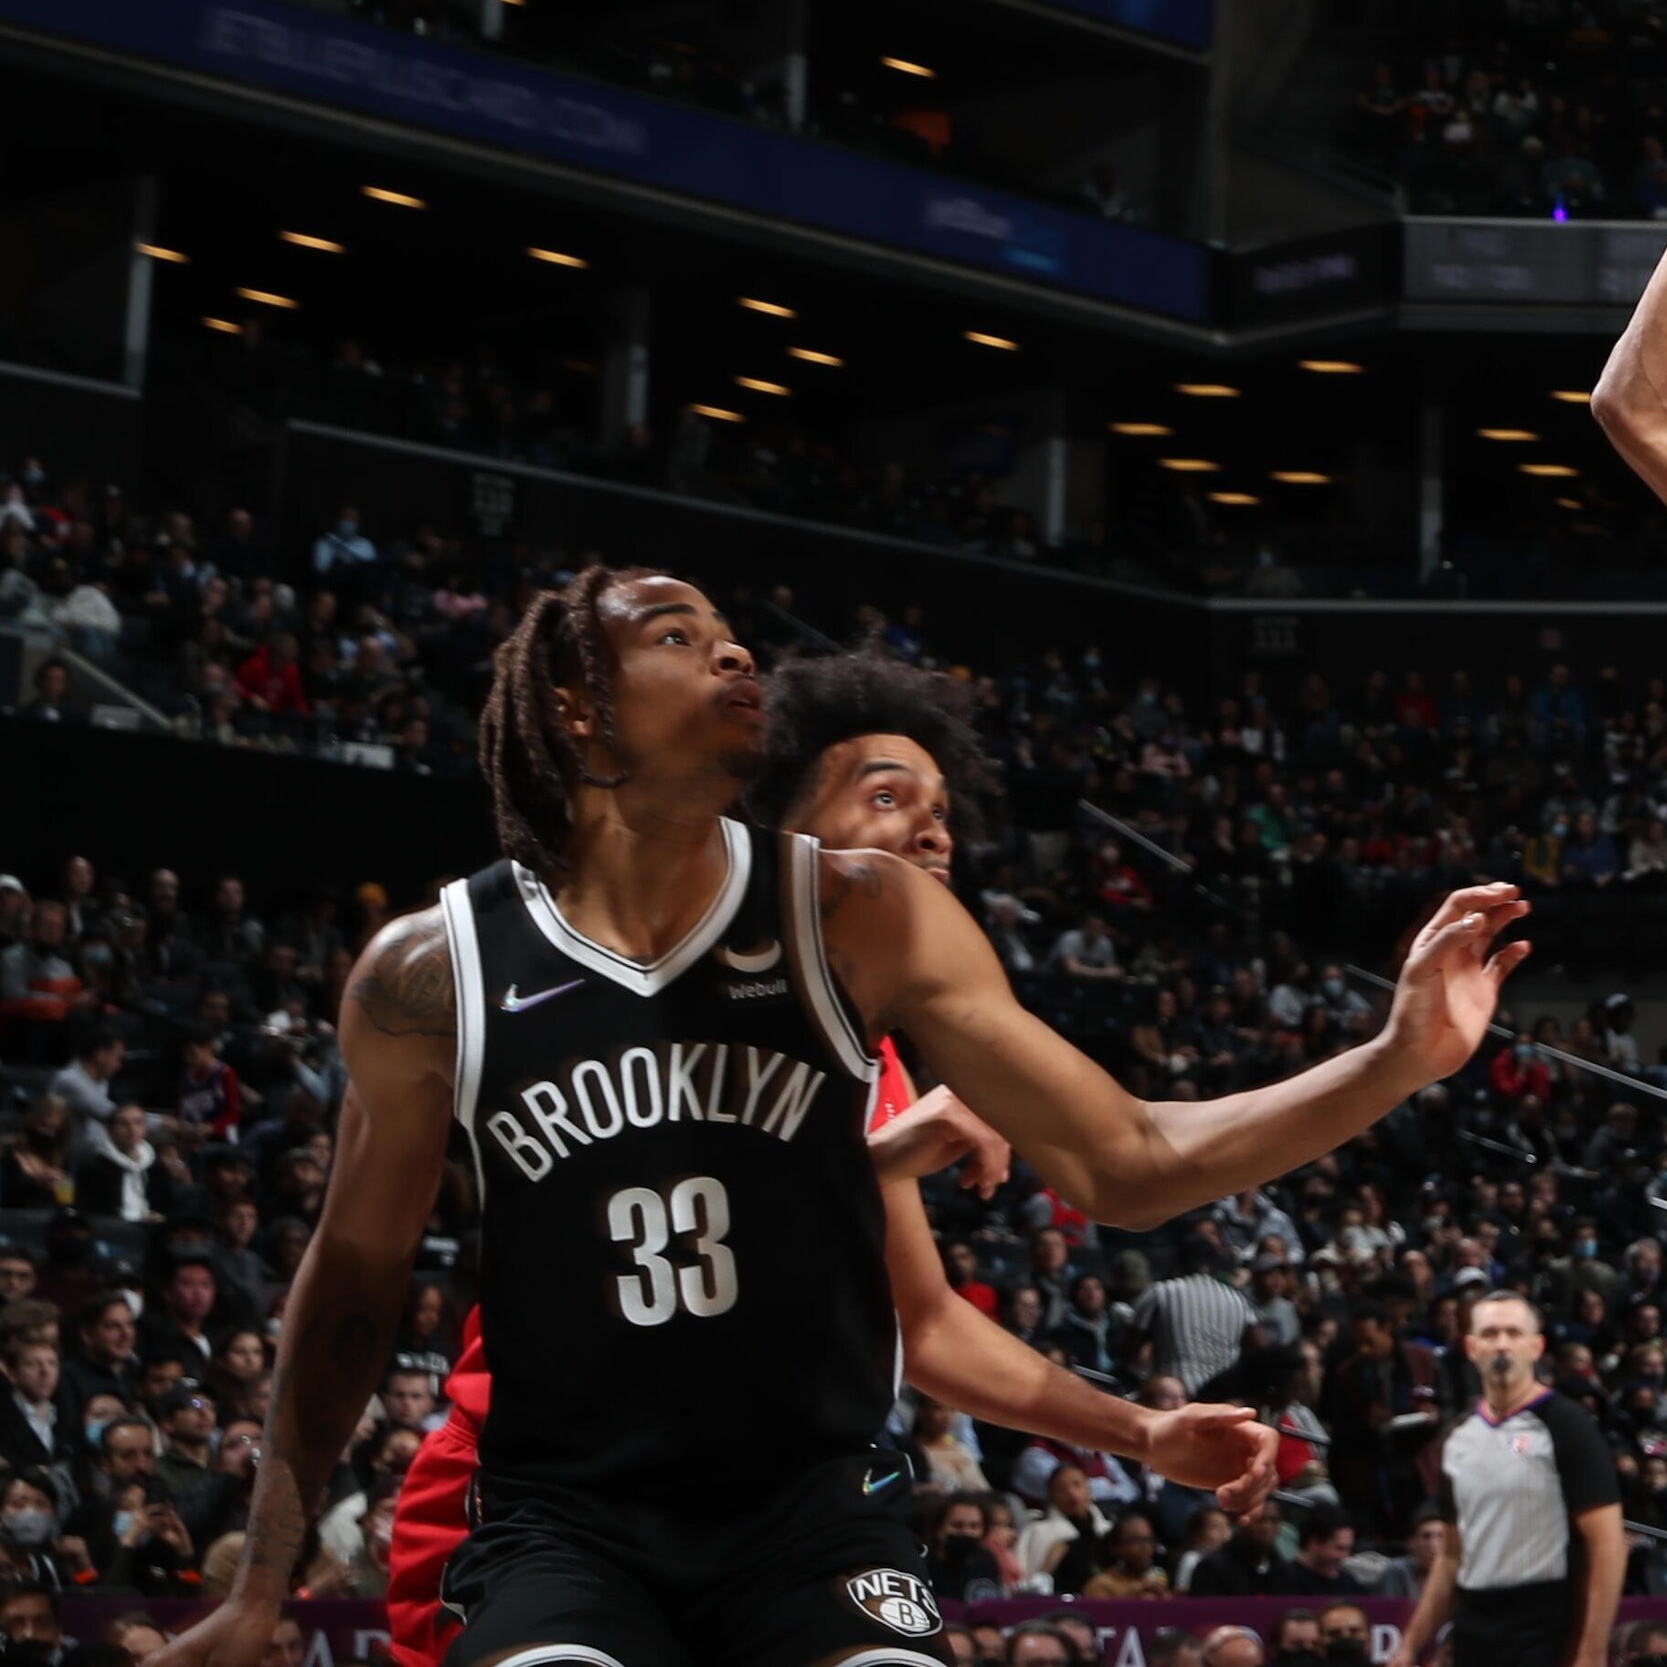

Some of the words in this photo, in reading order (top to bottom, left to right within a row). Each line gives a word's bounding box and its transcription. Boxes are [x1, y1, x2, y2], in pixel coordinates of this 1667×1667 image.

[729, 979, 788, 1000] Webull
[486, 1042, 828, 1183] BROOKLYN
[606, 1176, 740, 1327] 33
[856, 1572, 941, 1618] NETS
